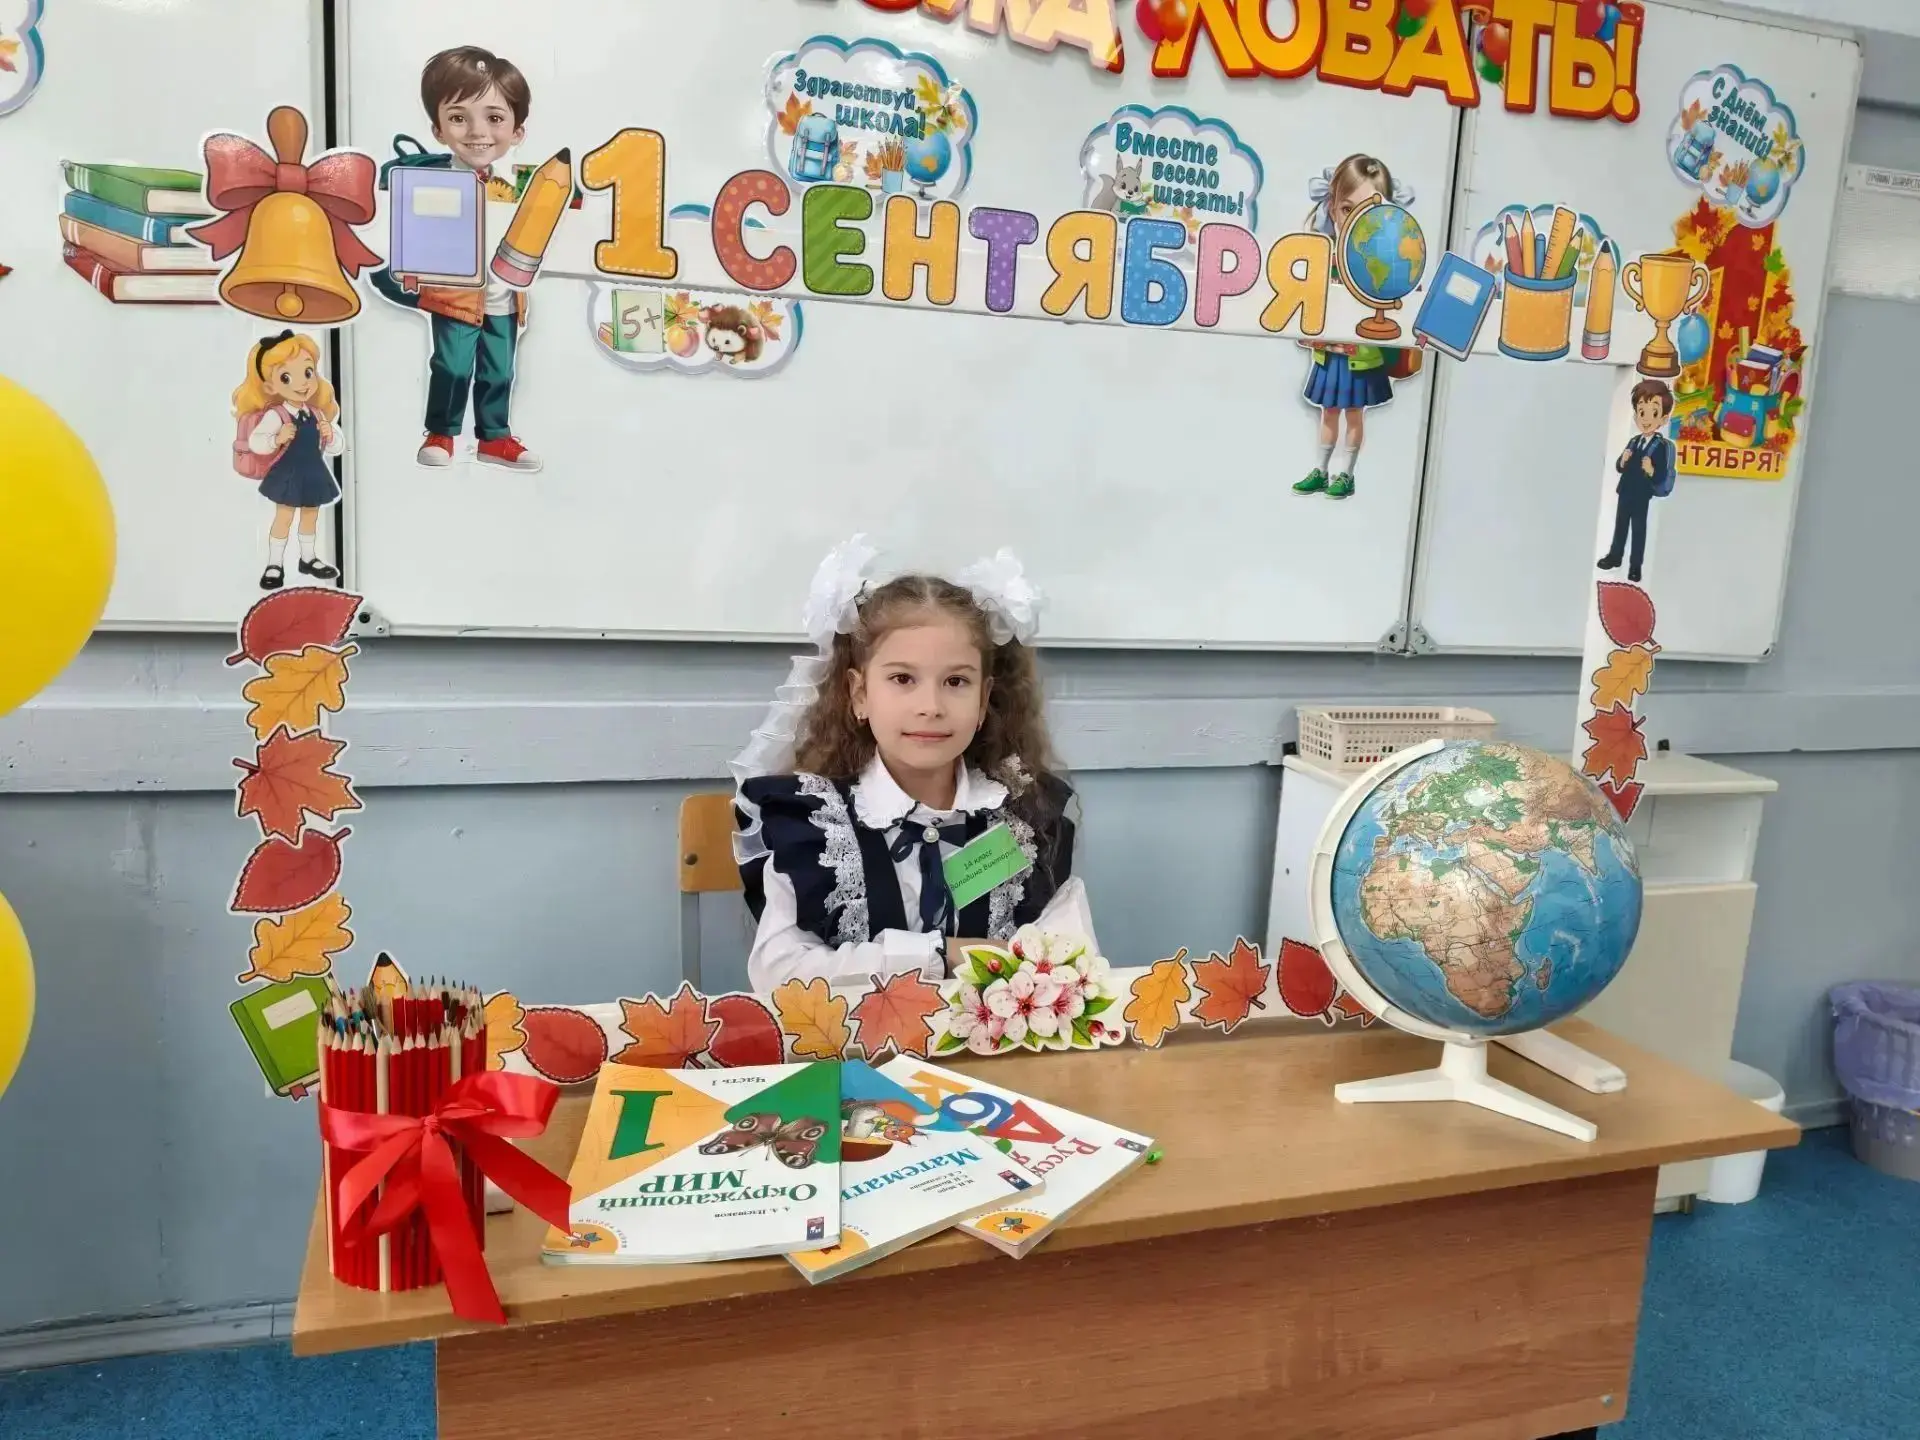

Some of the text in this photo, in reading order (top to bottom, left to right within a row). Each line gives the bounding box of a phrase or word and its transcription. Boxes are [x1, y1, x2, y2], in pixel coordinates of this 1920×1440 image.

[1713, 77, 1725, 99] С
[1115, 122, 1218, 166] Вместе
[1152, 162, 1219, 189] весело
[1153, 185, 1244, 216] шагать!
[581, 128, 1332, 336] 1 СЕНТЯБРЯ
[1678, 444, 1782, 473] НТЯБРЯ!
[608, 1090, 673, 1160] 1
[1032, 1137, 1101, 1177] Русск
[639, 1169, 748, 1193] МИР
[840, 1148, 982, 1200] Математи
[598, 1183, 818, 1211] Окружающий
